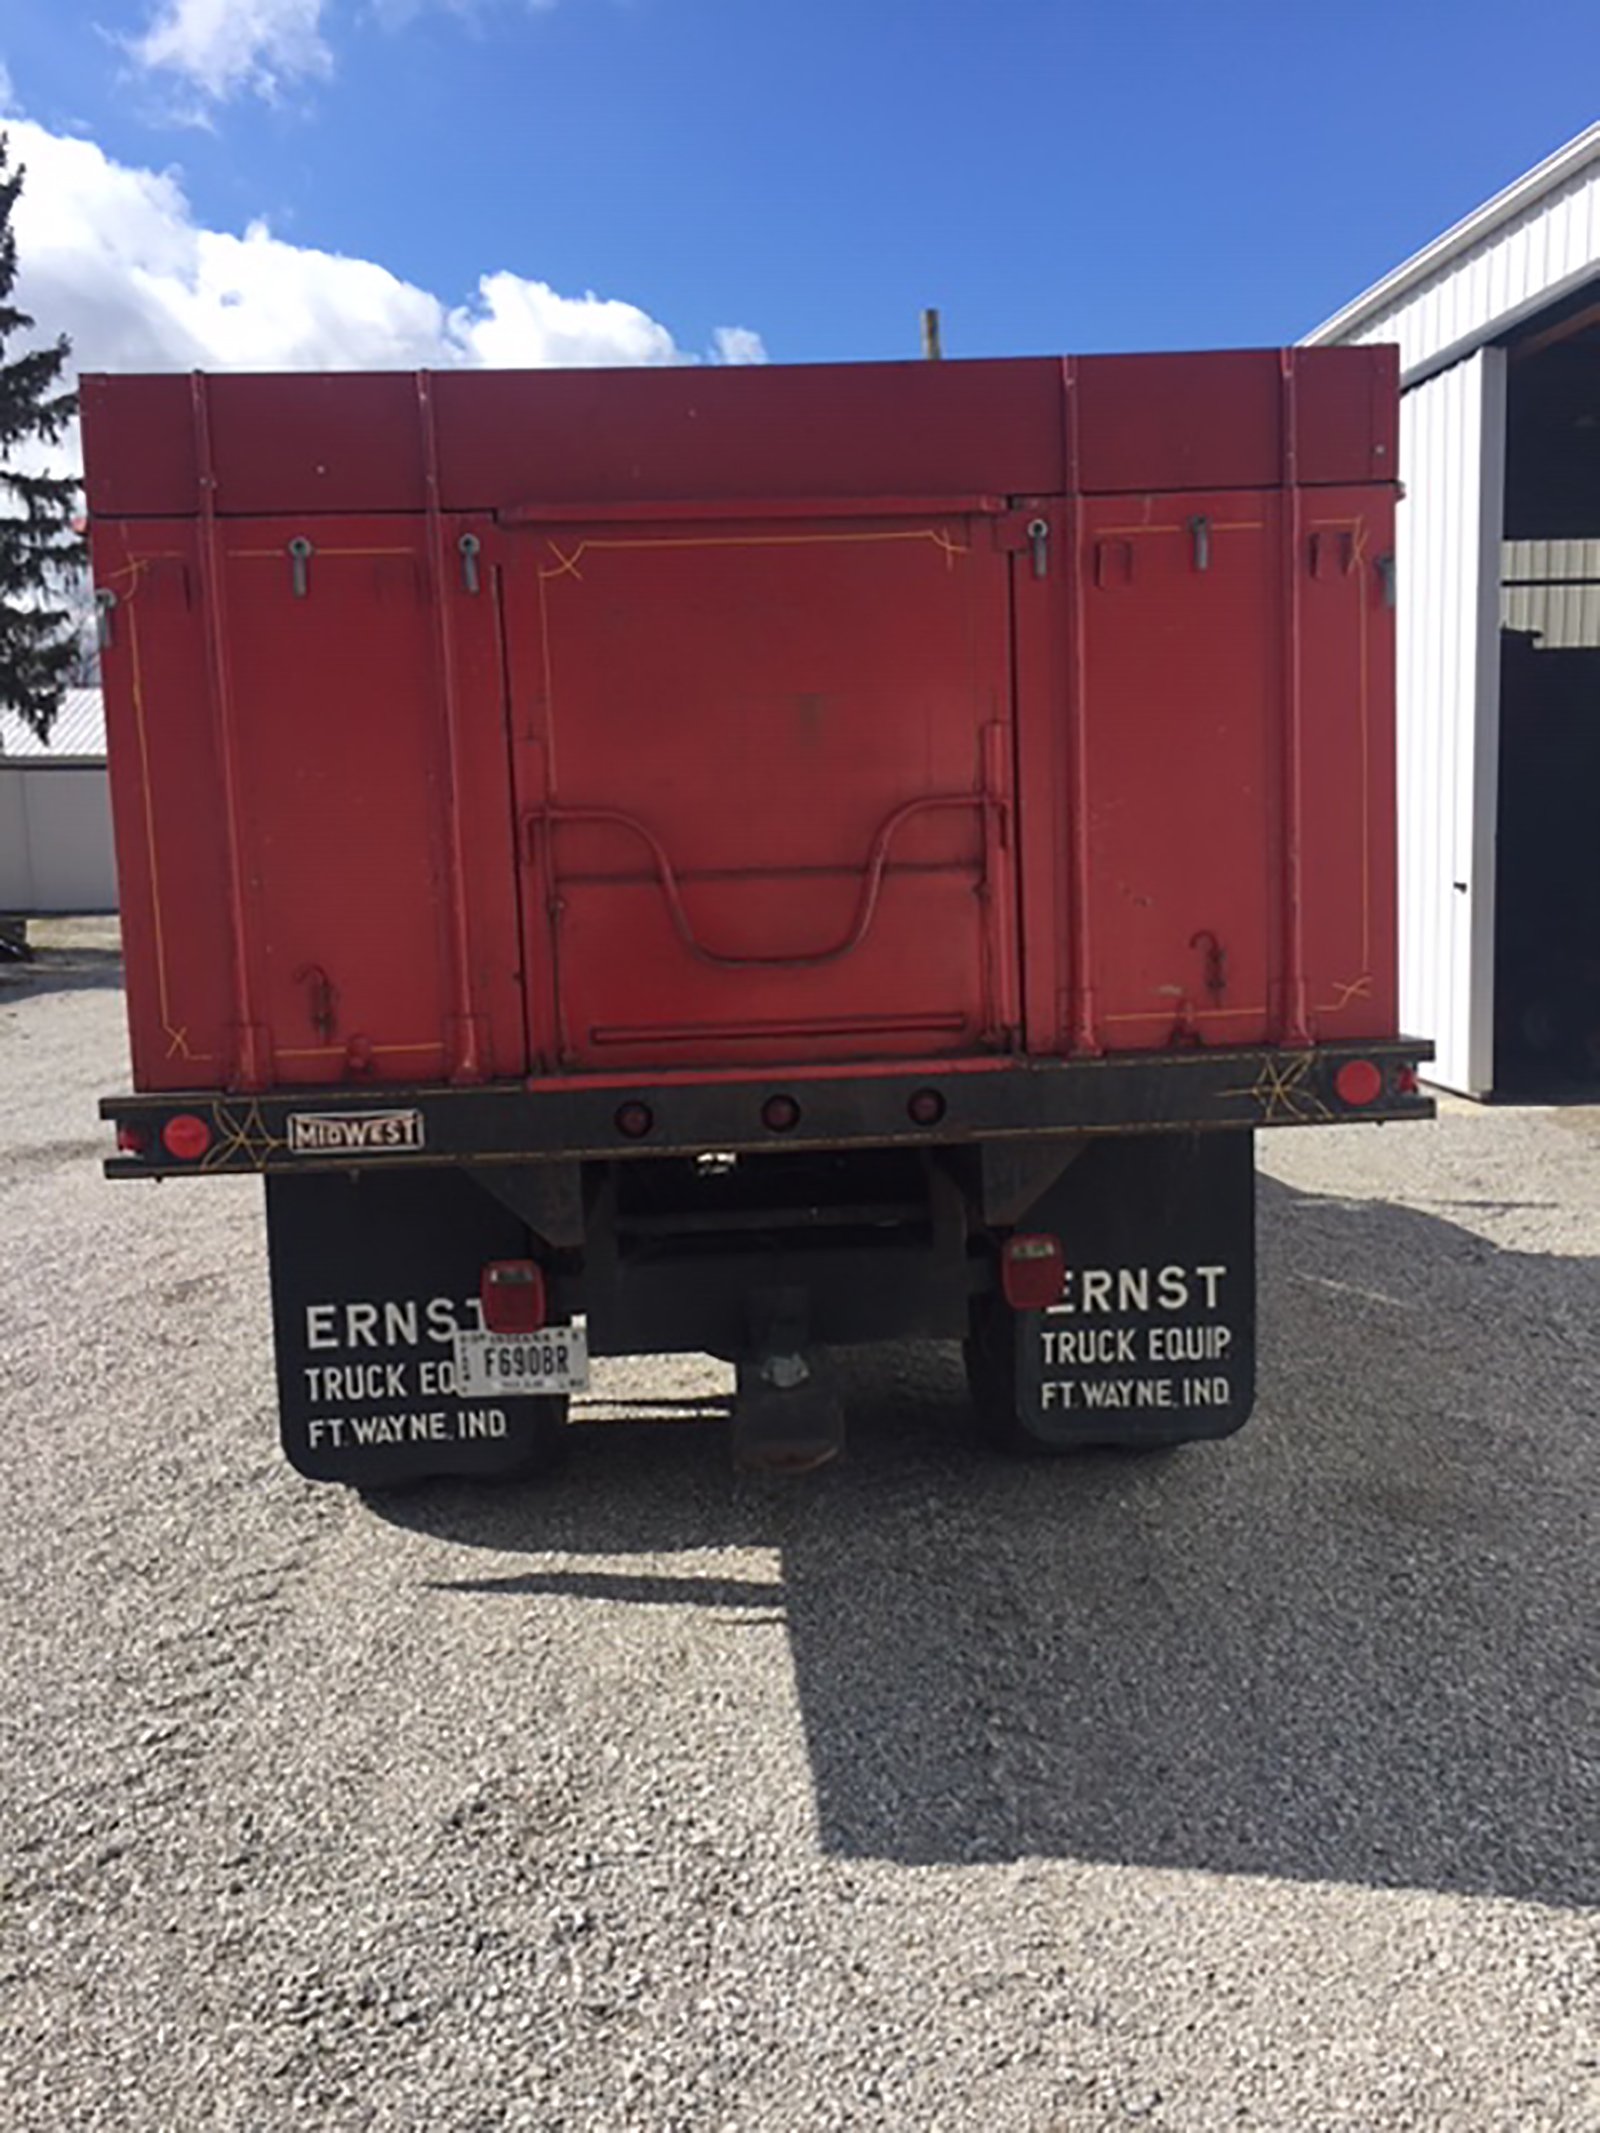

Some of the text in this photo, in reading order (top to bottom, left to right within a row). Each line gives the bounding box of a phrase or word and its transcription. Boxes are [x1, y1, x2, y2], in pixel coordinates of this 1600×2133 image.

[296, 1118, 416, 1147] MIDWEST
[484, 1345, 569, 1377] F690BR
[1040, 1327, 1136, 1364] TRUCK
[305, 1362, 408, 1402] TRUCK
